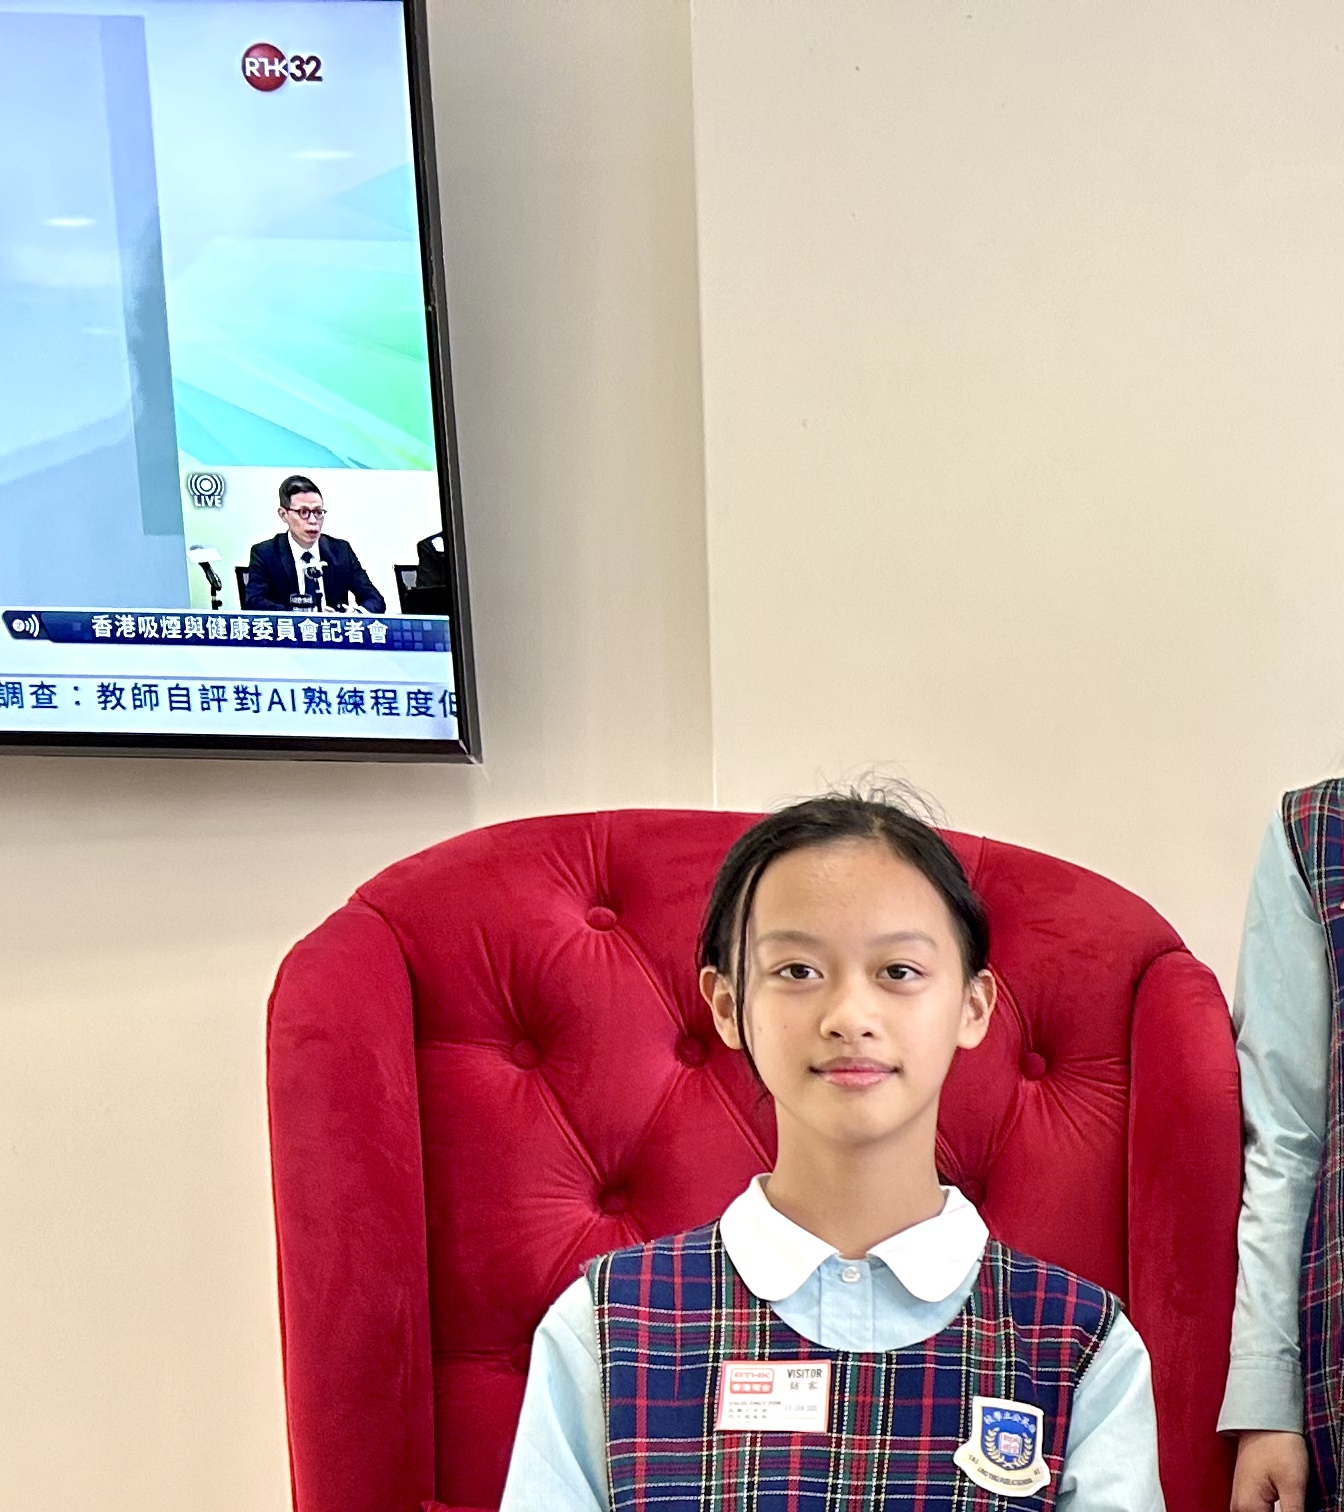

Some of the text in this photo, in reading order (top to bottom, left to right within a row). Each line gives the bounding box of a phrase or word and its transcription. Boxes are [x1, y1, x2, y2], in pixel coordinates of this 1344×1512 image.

[194, 495, 222, 507] LIVE
[92, 614, 388, 644] 香港吸煙與健康委員會記者會
[787, 1368, 823, 1379] VISITOR
